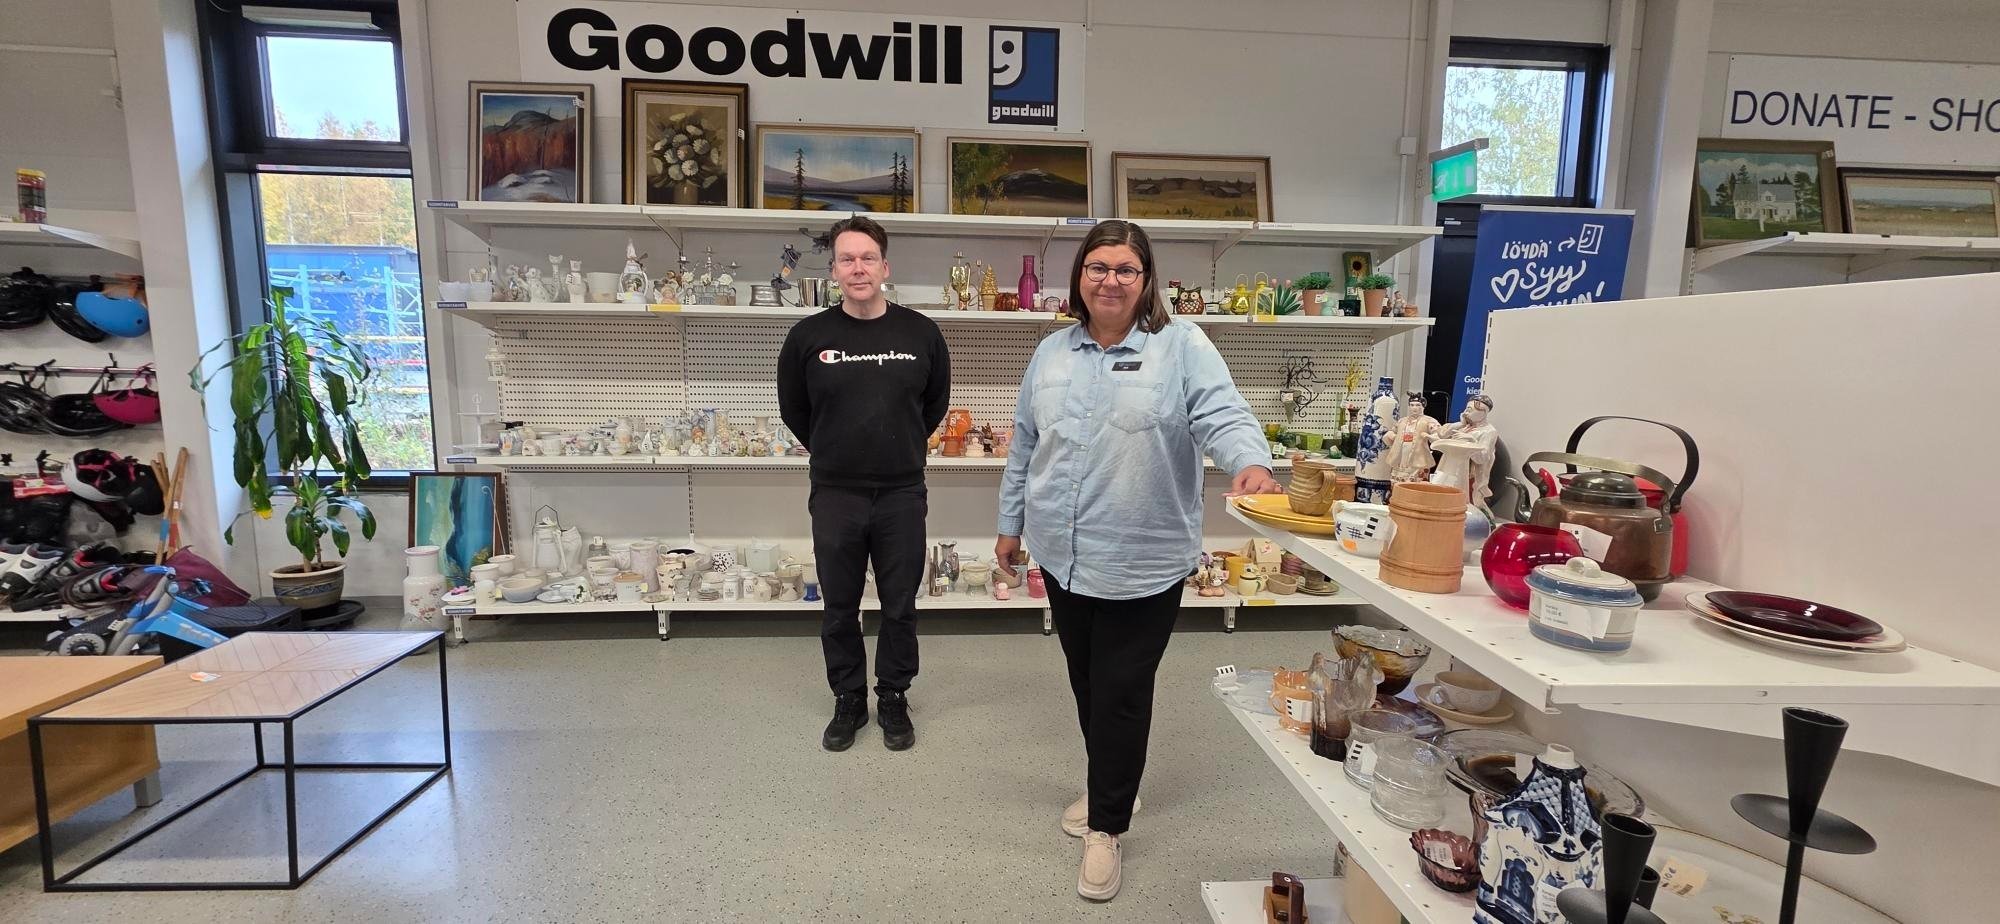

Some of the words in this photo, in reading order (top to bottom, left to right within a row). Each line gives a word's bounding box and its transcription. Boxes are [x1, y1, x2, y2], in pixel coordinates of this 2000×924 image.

[547, 7, 963, 84] Goodwill
[992, 104, 1055, 121] goodwill
[1730, 90, 1893, 129] DONATE
[1502, 240, 1552, 260] LÖYDÄ
[1520, 260, 1587, 300] Syy
[819, 349, 917, 366] Champion
